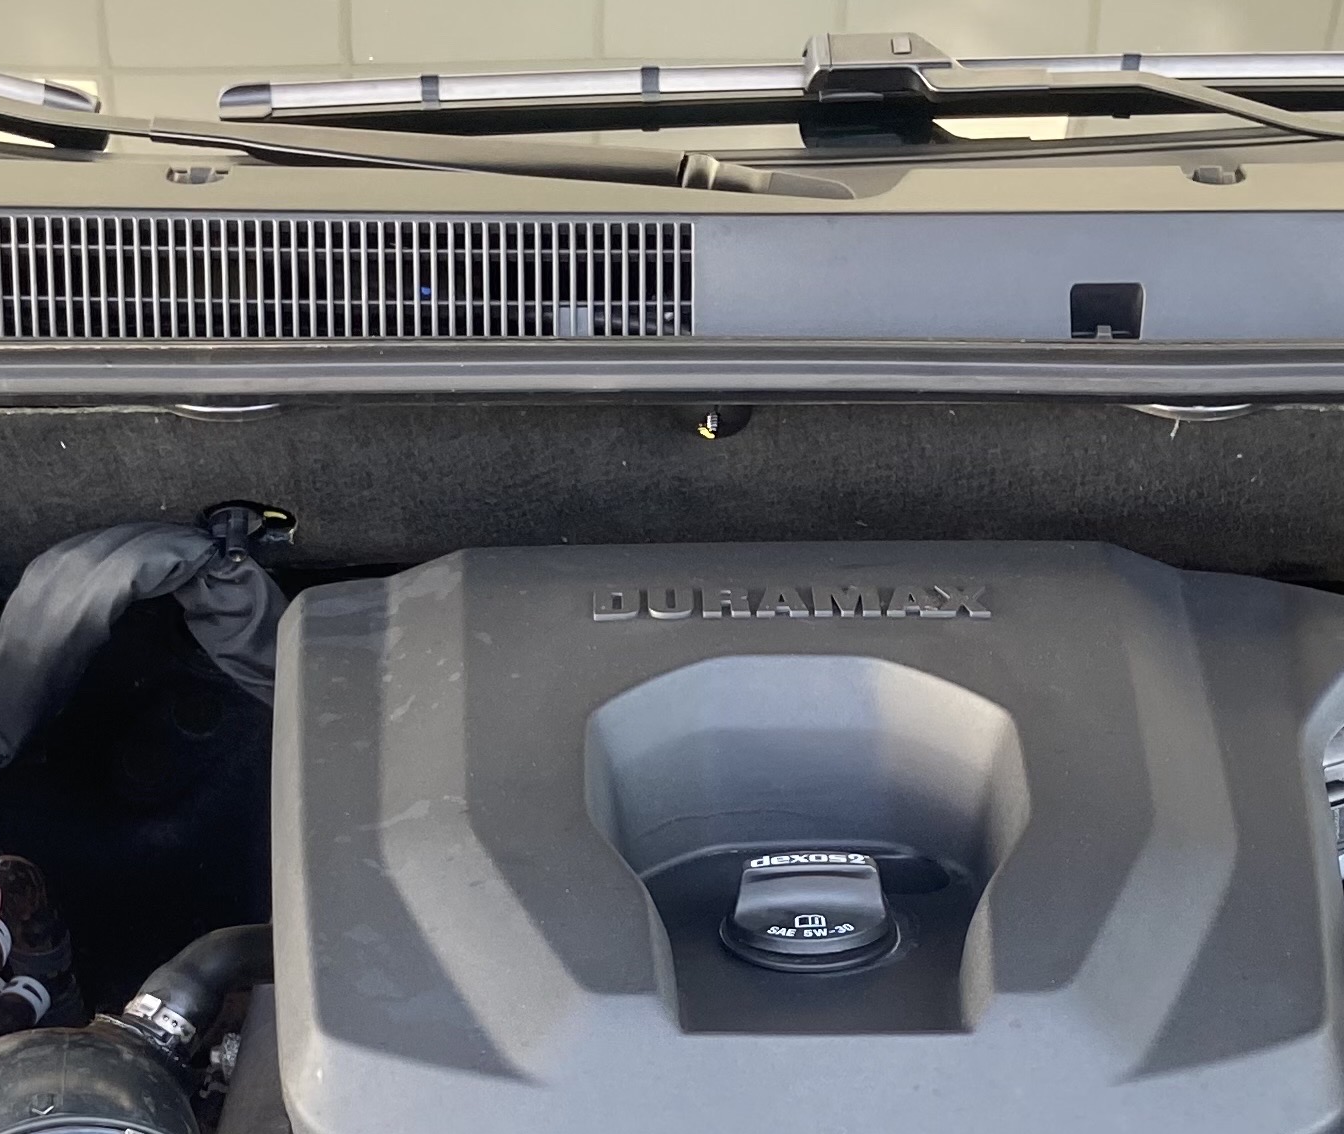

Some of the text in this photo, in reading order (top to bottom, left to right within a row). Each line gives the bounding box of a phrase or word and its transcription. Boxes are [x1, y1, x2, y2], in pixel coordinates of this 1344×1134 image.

[592, 584, 991, 622] DURAMAX
[750, 853, 867, 868] dexos2
[766, 923, 855, 937] SAE 5W-30
